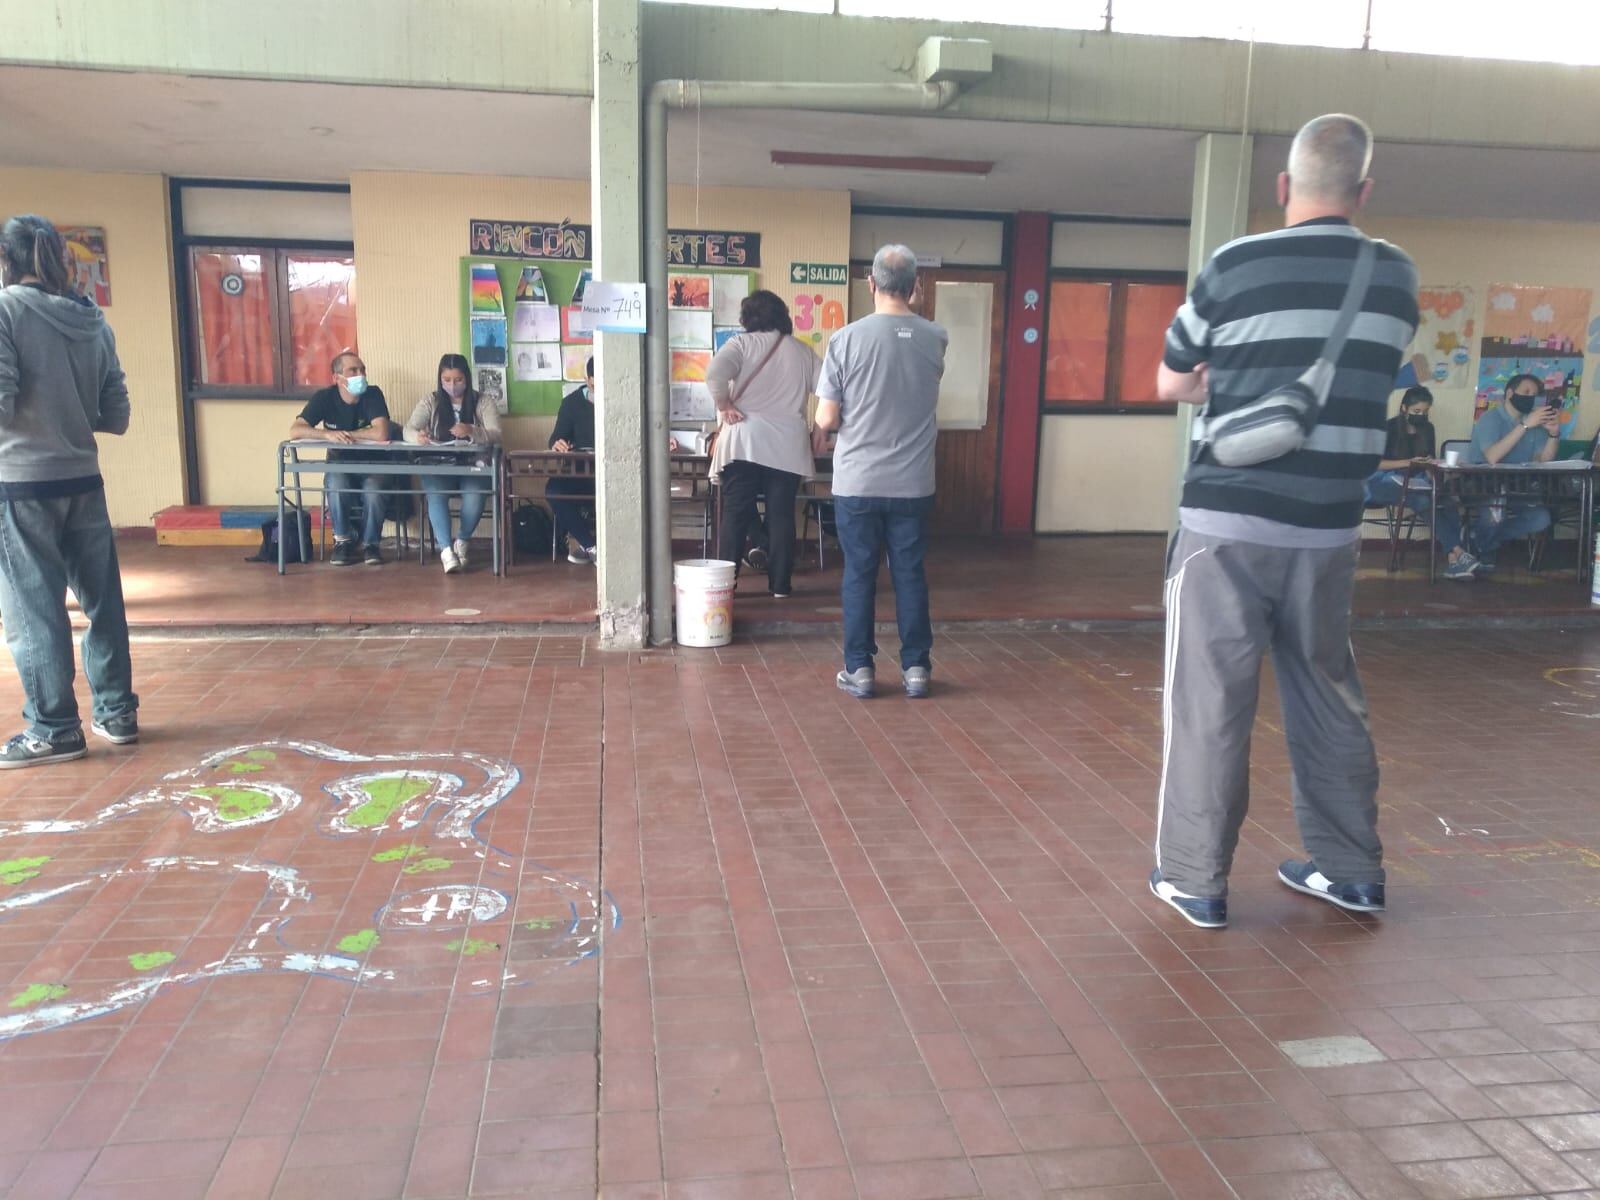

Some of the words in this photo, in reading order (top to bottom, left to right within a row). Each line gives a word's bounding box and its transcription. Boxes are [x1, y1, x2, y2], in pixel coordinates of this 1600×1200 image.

[472, 217, 585, 257] RINCÓN
[667, 233, 745, 264] RTES
[810, 268, 846, 281] SALIDA
